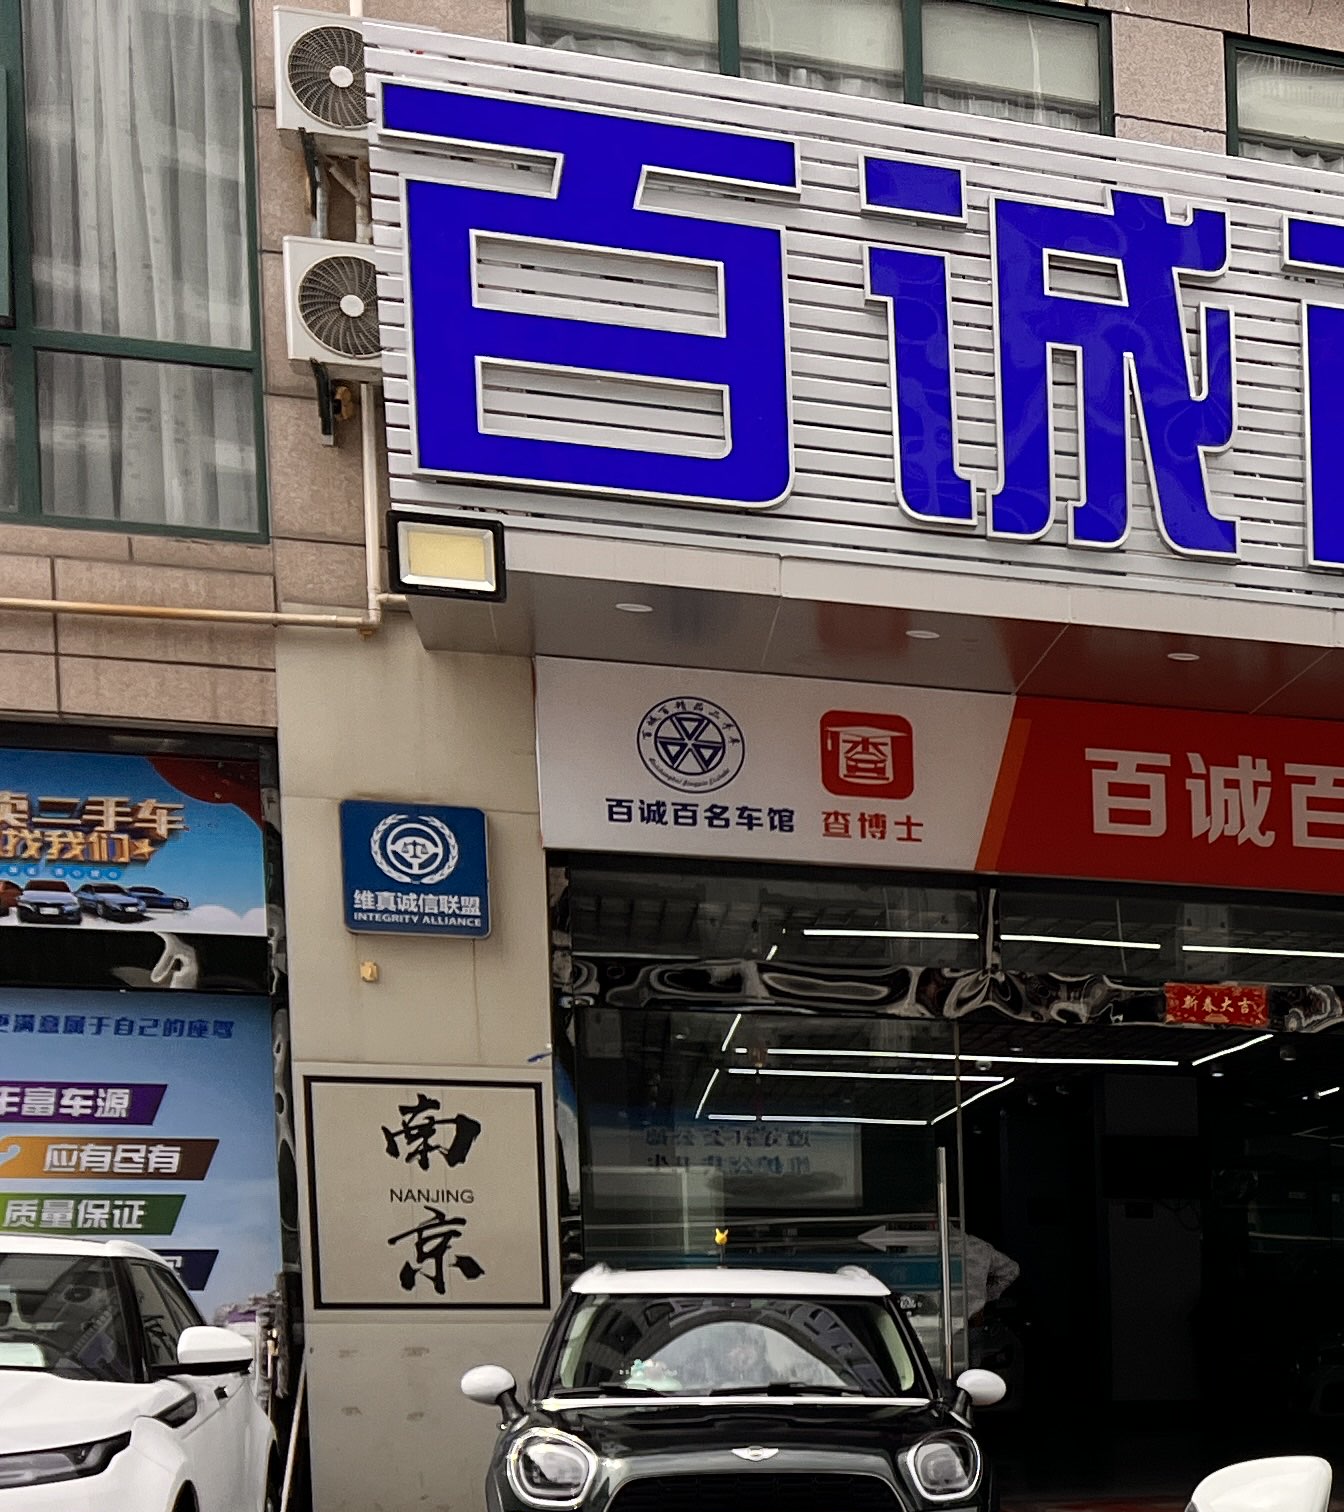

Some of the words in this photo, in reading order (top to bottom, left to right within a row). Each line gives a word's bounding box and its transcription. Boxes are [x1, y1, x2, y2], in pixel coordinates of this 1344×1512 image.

[605, 797, 796, 833] 百诚百名车馆
[821, 810, 925, 843] 查博士
[353, 889, 481, 916] 维真诚信联盟
[353, 911, 419, 924] INTEGRITY
[422, 916, 482, 927] ALLIANCE
[1182, 994, 1249, 1014] 新春大吉
[43, 1143, 181, 1174] 应有尽有
[390, 1188, 475, 1204] NANJING
[1, 1199, 146, 1230] 质量保证
